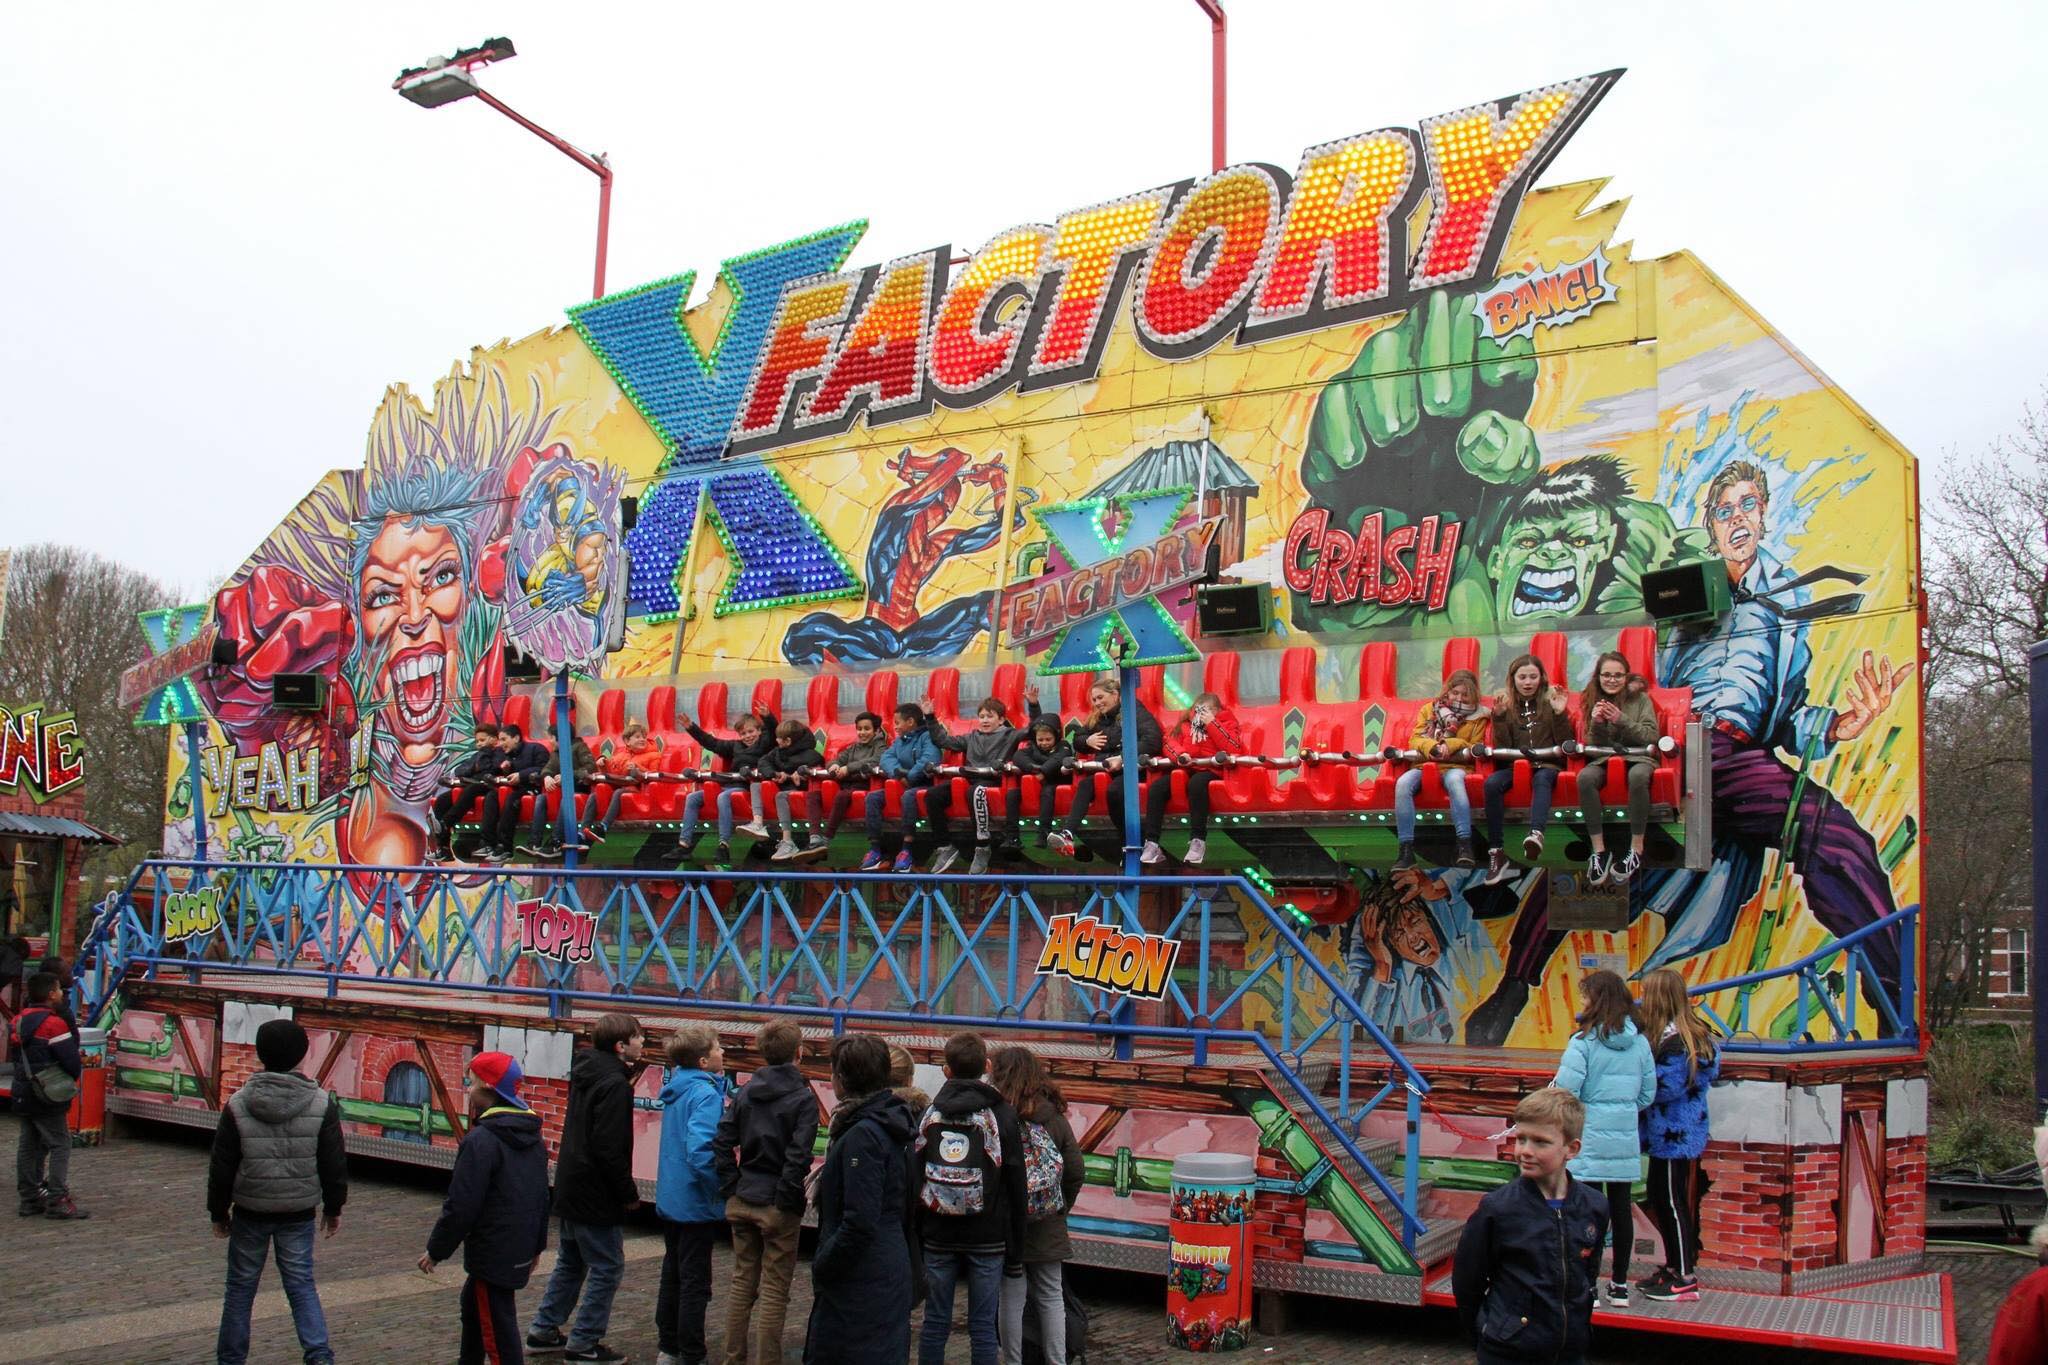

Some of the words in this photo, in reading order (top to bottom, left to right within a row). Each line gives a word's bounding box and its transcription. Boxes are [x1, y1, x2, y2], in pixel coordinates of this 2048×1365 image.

[722, 68, 1624, 456] FACTORY
[1483, 258, 1606, 339] BANG!
[1008, 517, 1221, 641] FACTORY
[1282, 507, 1464, 613] CRASH
[0, 705, 84, 794] NE
[202, 741, 320, 818] YEAH
[165, 887, 222, 942] SHOCK
[515, 897, 598, 963] TOP!!
[1580, 883, 1618, 896] KMG
